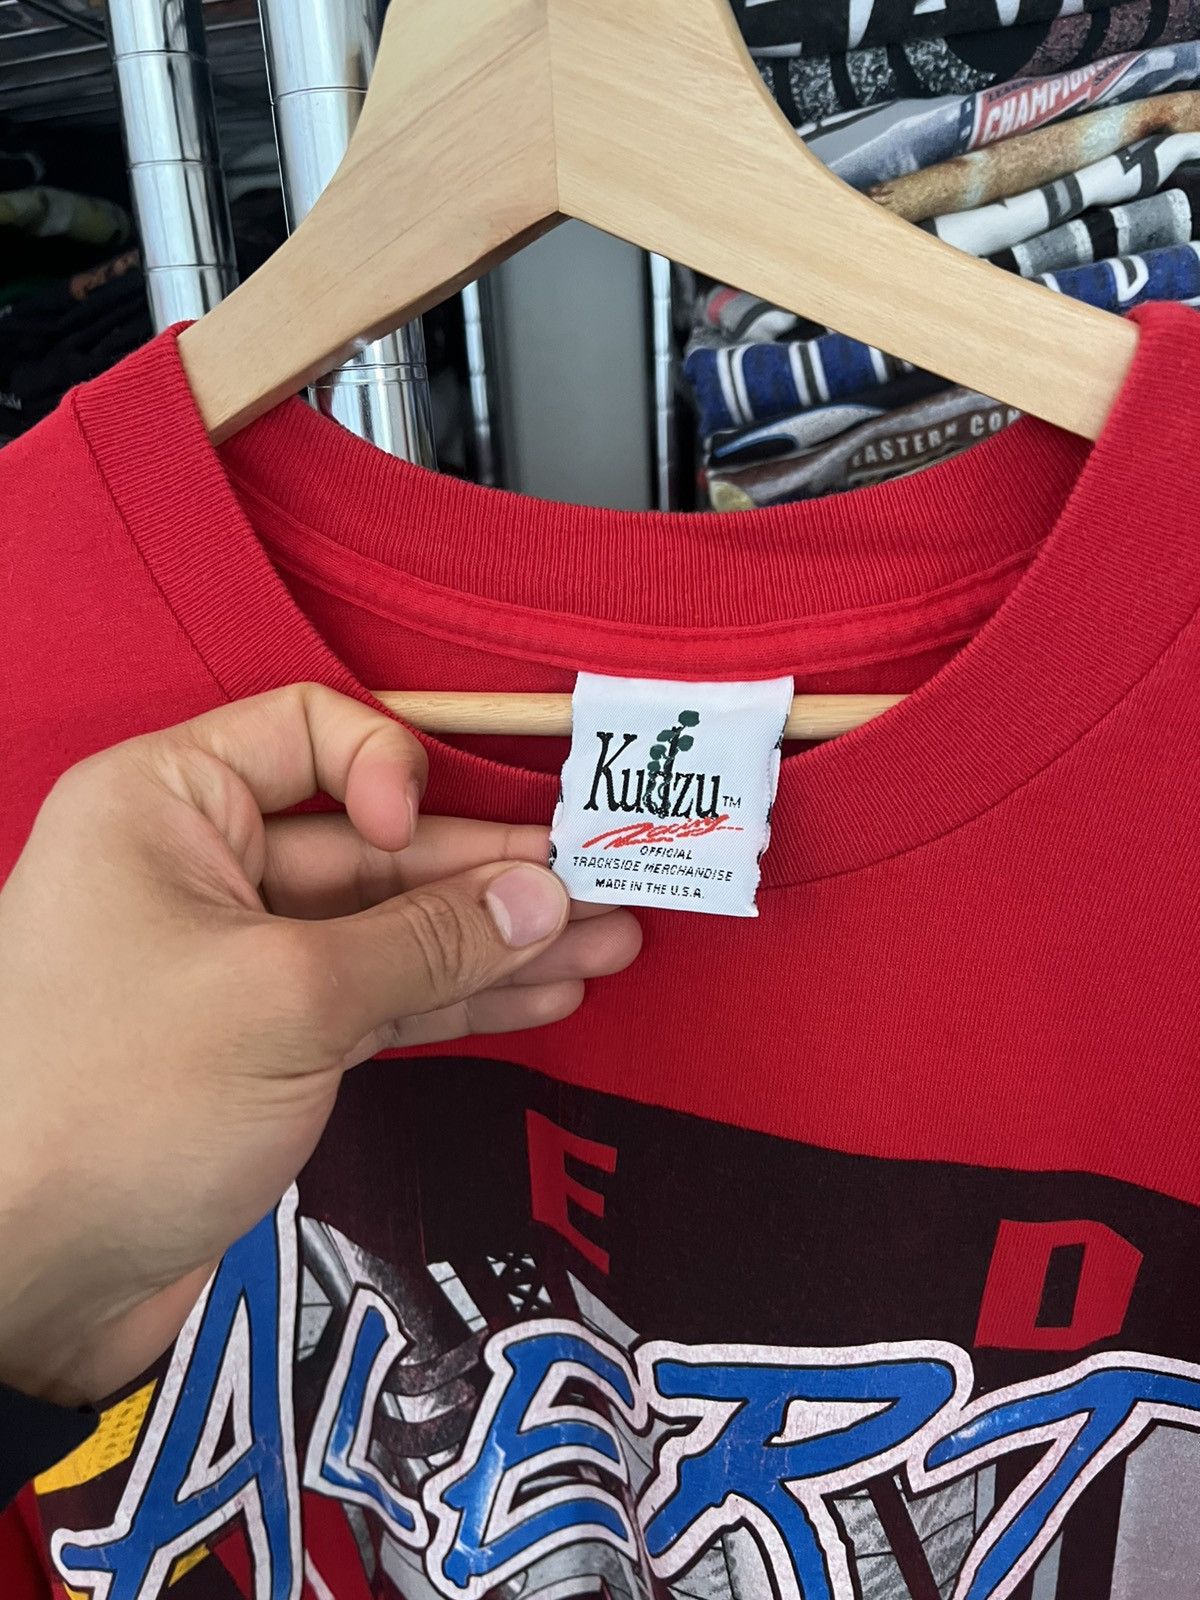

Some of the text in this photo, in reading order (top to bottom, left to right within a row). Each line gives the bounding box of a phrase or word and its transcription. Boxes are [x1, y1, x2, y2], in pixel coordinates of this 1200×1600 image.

[980, 55, 1120, 145] CHAMPION
[583, 726, 721, 819] Kudzu
[639, 845, 693, 860] OFFICIAL
[572, 856, 734, 882] TRACKSIDE MERCHANDISE
[595, 878, 705, 899] MADE IN THE U.S.A.
